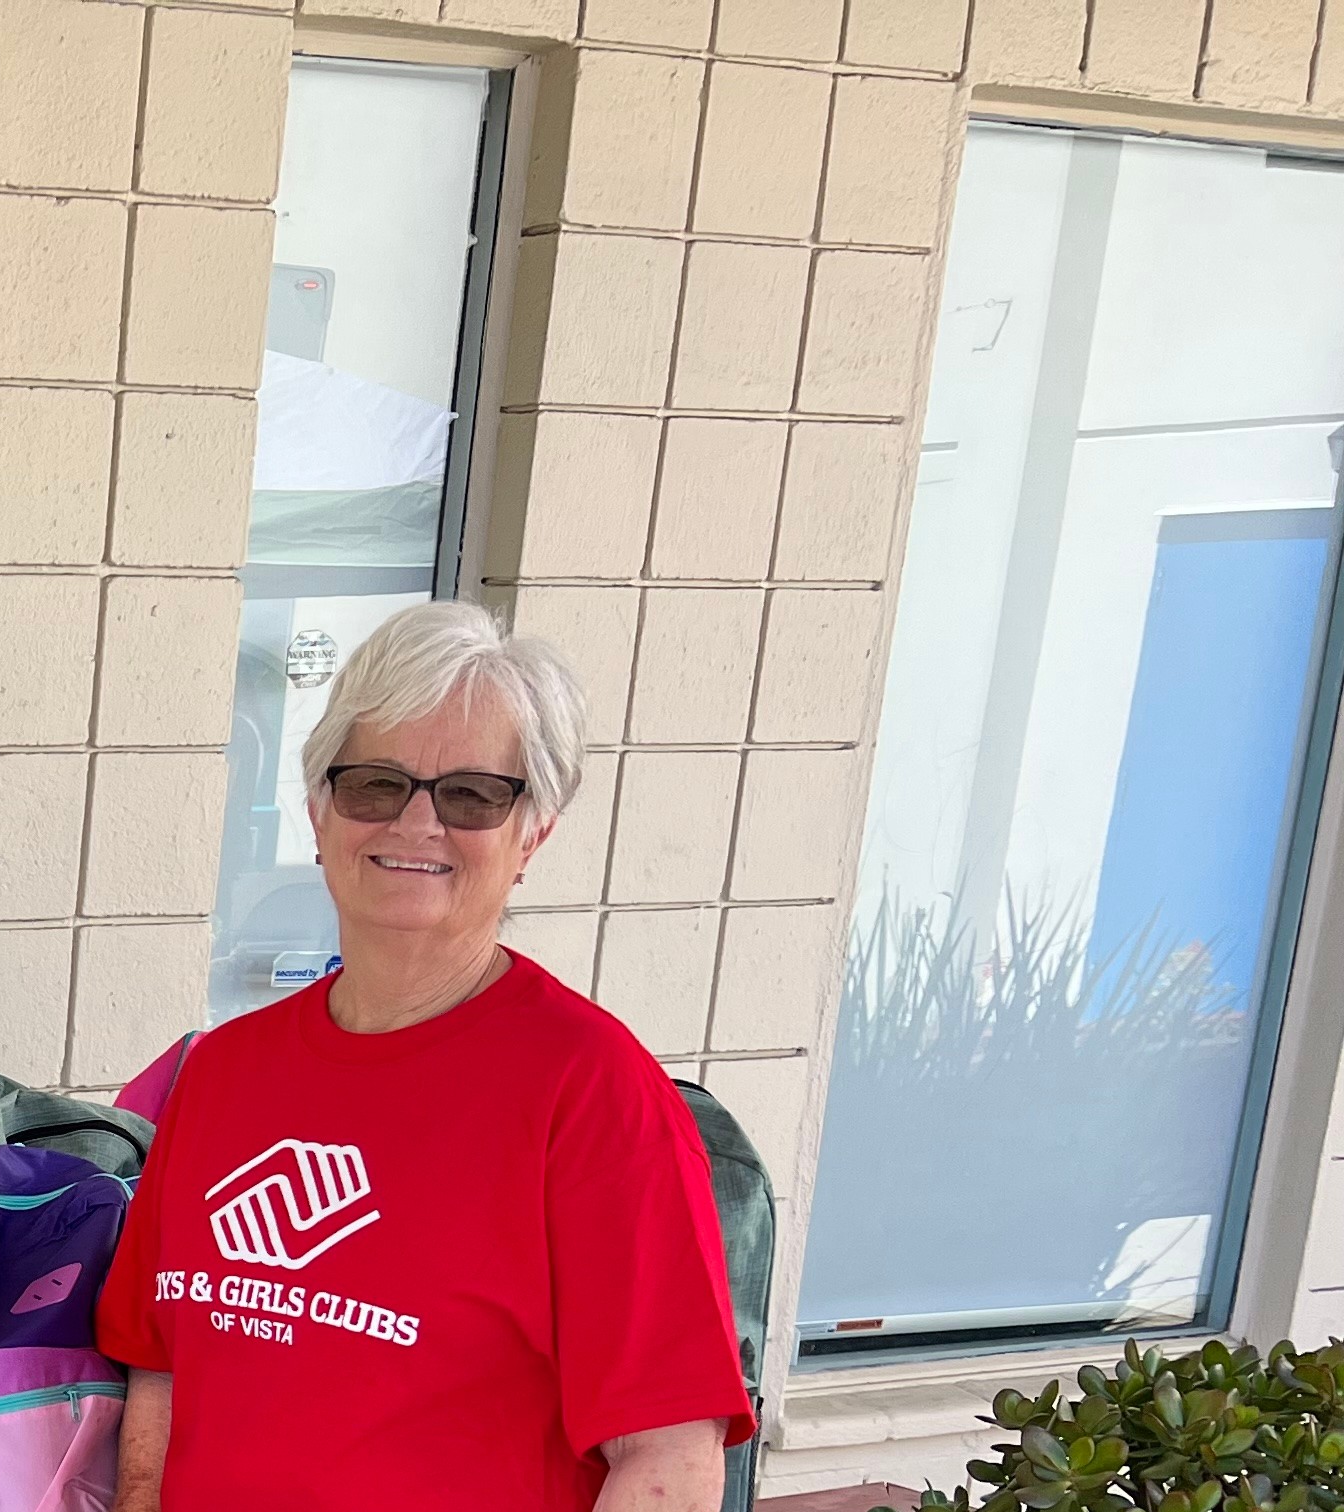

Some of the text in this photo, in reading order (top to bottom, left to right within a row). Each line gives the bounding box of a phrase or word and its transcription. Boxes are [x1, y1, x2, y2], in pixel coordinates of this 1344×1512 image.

[289, 650, 336, 659] WARNING
[275, 969, 307, 977] secured
[309, 969, 319, 979] by
[190, 1271, 213, 1303] &
[219, 1275, 306, 1318] GIRLS
[310, 1292, 420, 1348] CLUBS
[210, 1312, 293, 1346] OF VISTA
